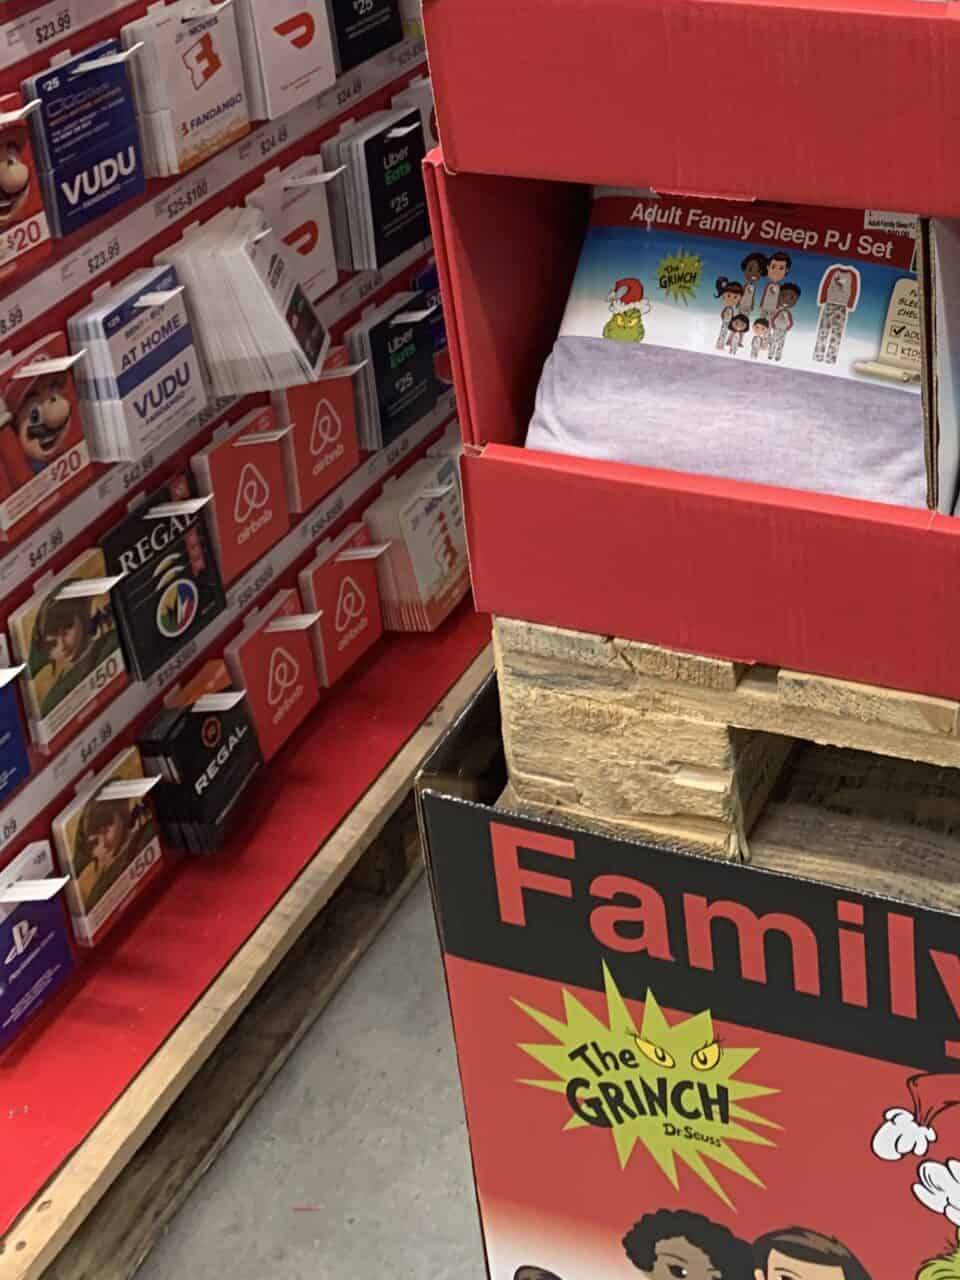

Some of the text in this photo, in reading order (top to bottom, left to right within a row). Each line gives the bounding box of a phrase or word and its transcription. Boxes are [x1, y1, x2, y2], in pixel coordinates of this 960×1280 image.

[35, 14, 71, 43] $23.99
[190, 93, 243, 131] FANDANGO
[61, 146, 136, 205] VUDU
[384, 147, 409, 169] Uber
[7, 220, 42, 253] $20
[631, 204, 895, 259] Adult Family Sleep PJ Set
[659, 270, 698, 289] GRINCH
[122, 347, 136, 370] AT
[141, 314, 180, 353] HOME
[134, 362, 190, 418] VUDU
[49, 452, 81, 483] $20
[312, 444, 345, 475] airbnb
[118, 508, 202, 575] REGAL
[237, 510, 273, 544] airbnb
[194, 724, 248, 796] REGAL
[568, 1041, 639, 1077] The
[566, 1074, 729, 1128] GRINCH
[684, 1126, 721, 1148] Seuss
